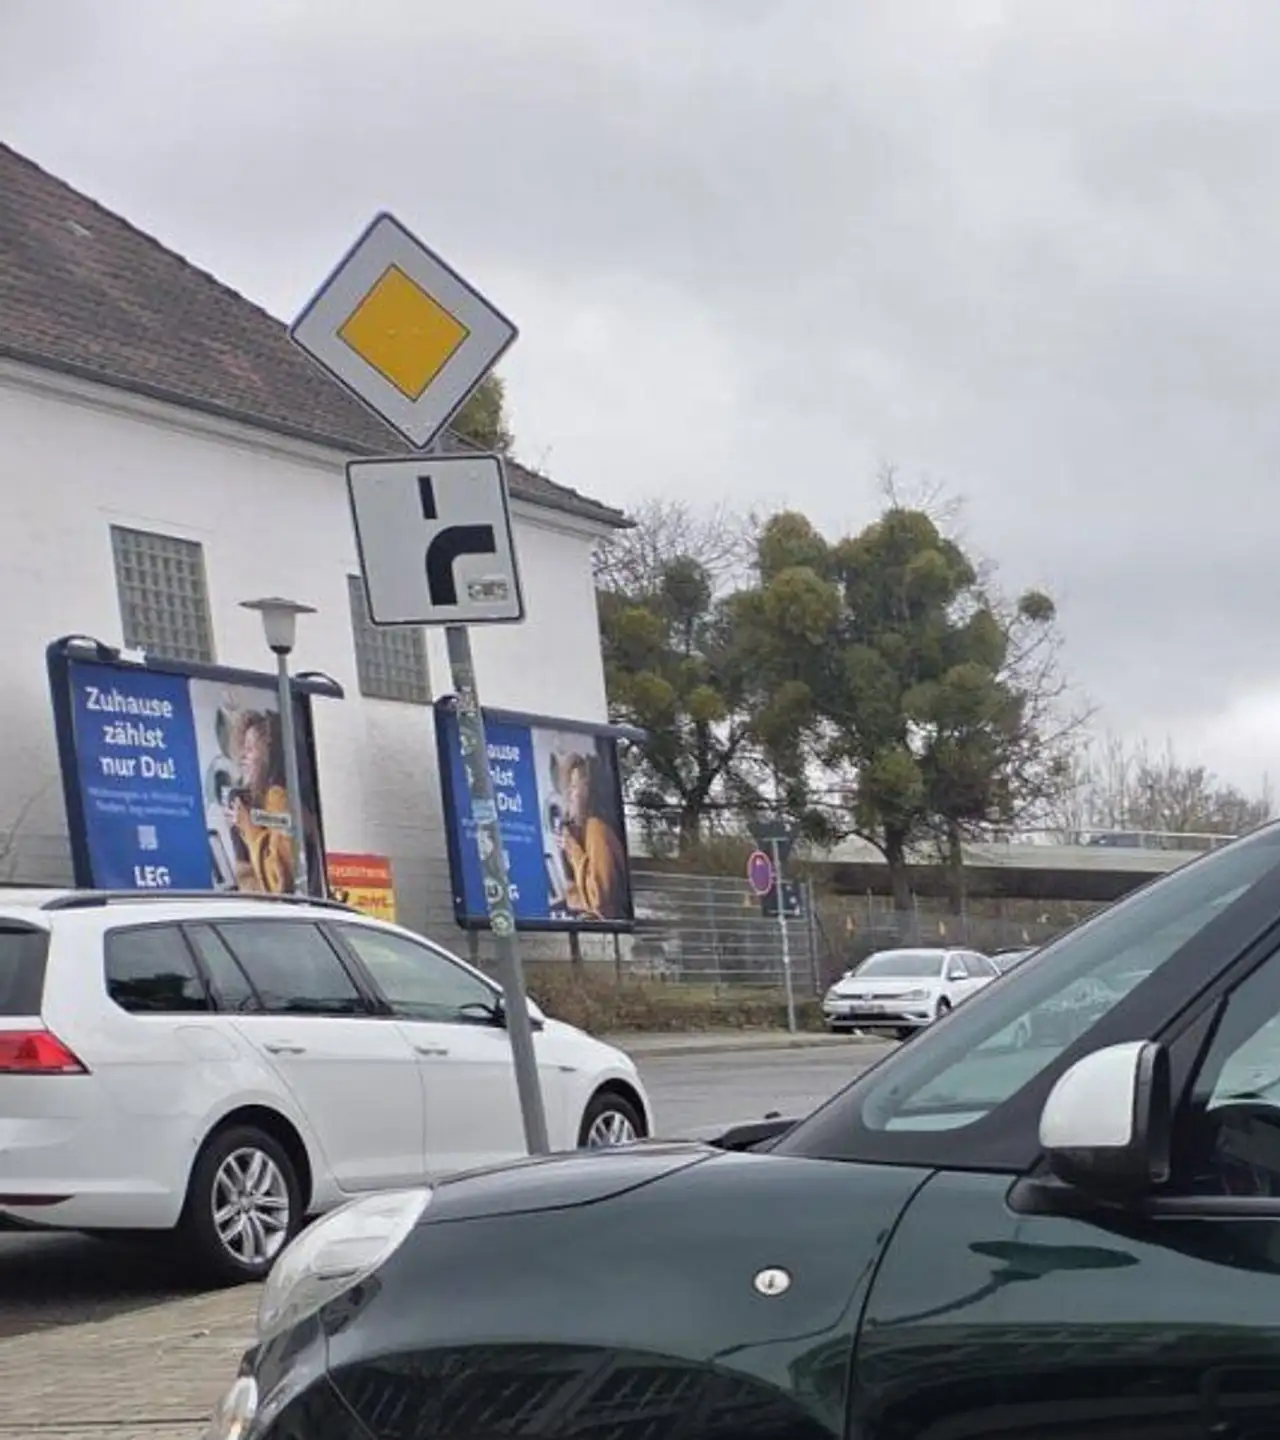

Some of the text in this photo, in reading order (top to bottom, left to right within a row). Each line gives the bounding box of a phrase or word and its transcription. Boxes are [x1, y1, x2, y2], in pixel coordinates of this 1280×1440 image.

[84, 686, 173, 718] Zuhause
[103, 720, 167, 749] zählst
[487, 743, 521, 762] ause
[99, 755, 176, 779] nur Du!
[133, 865, 170, 888] LEG
